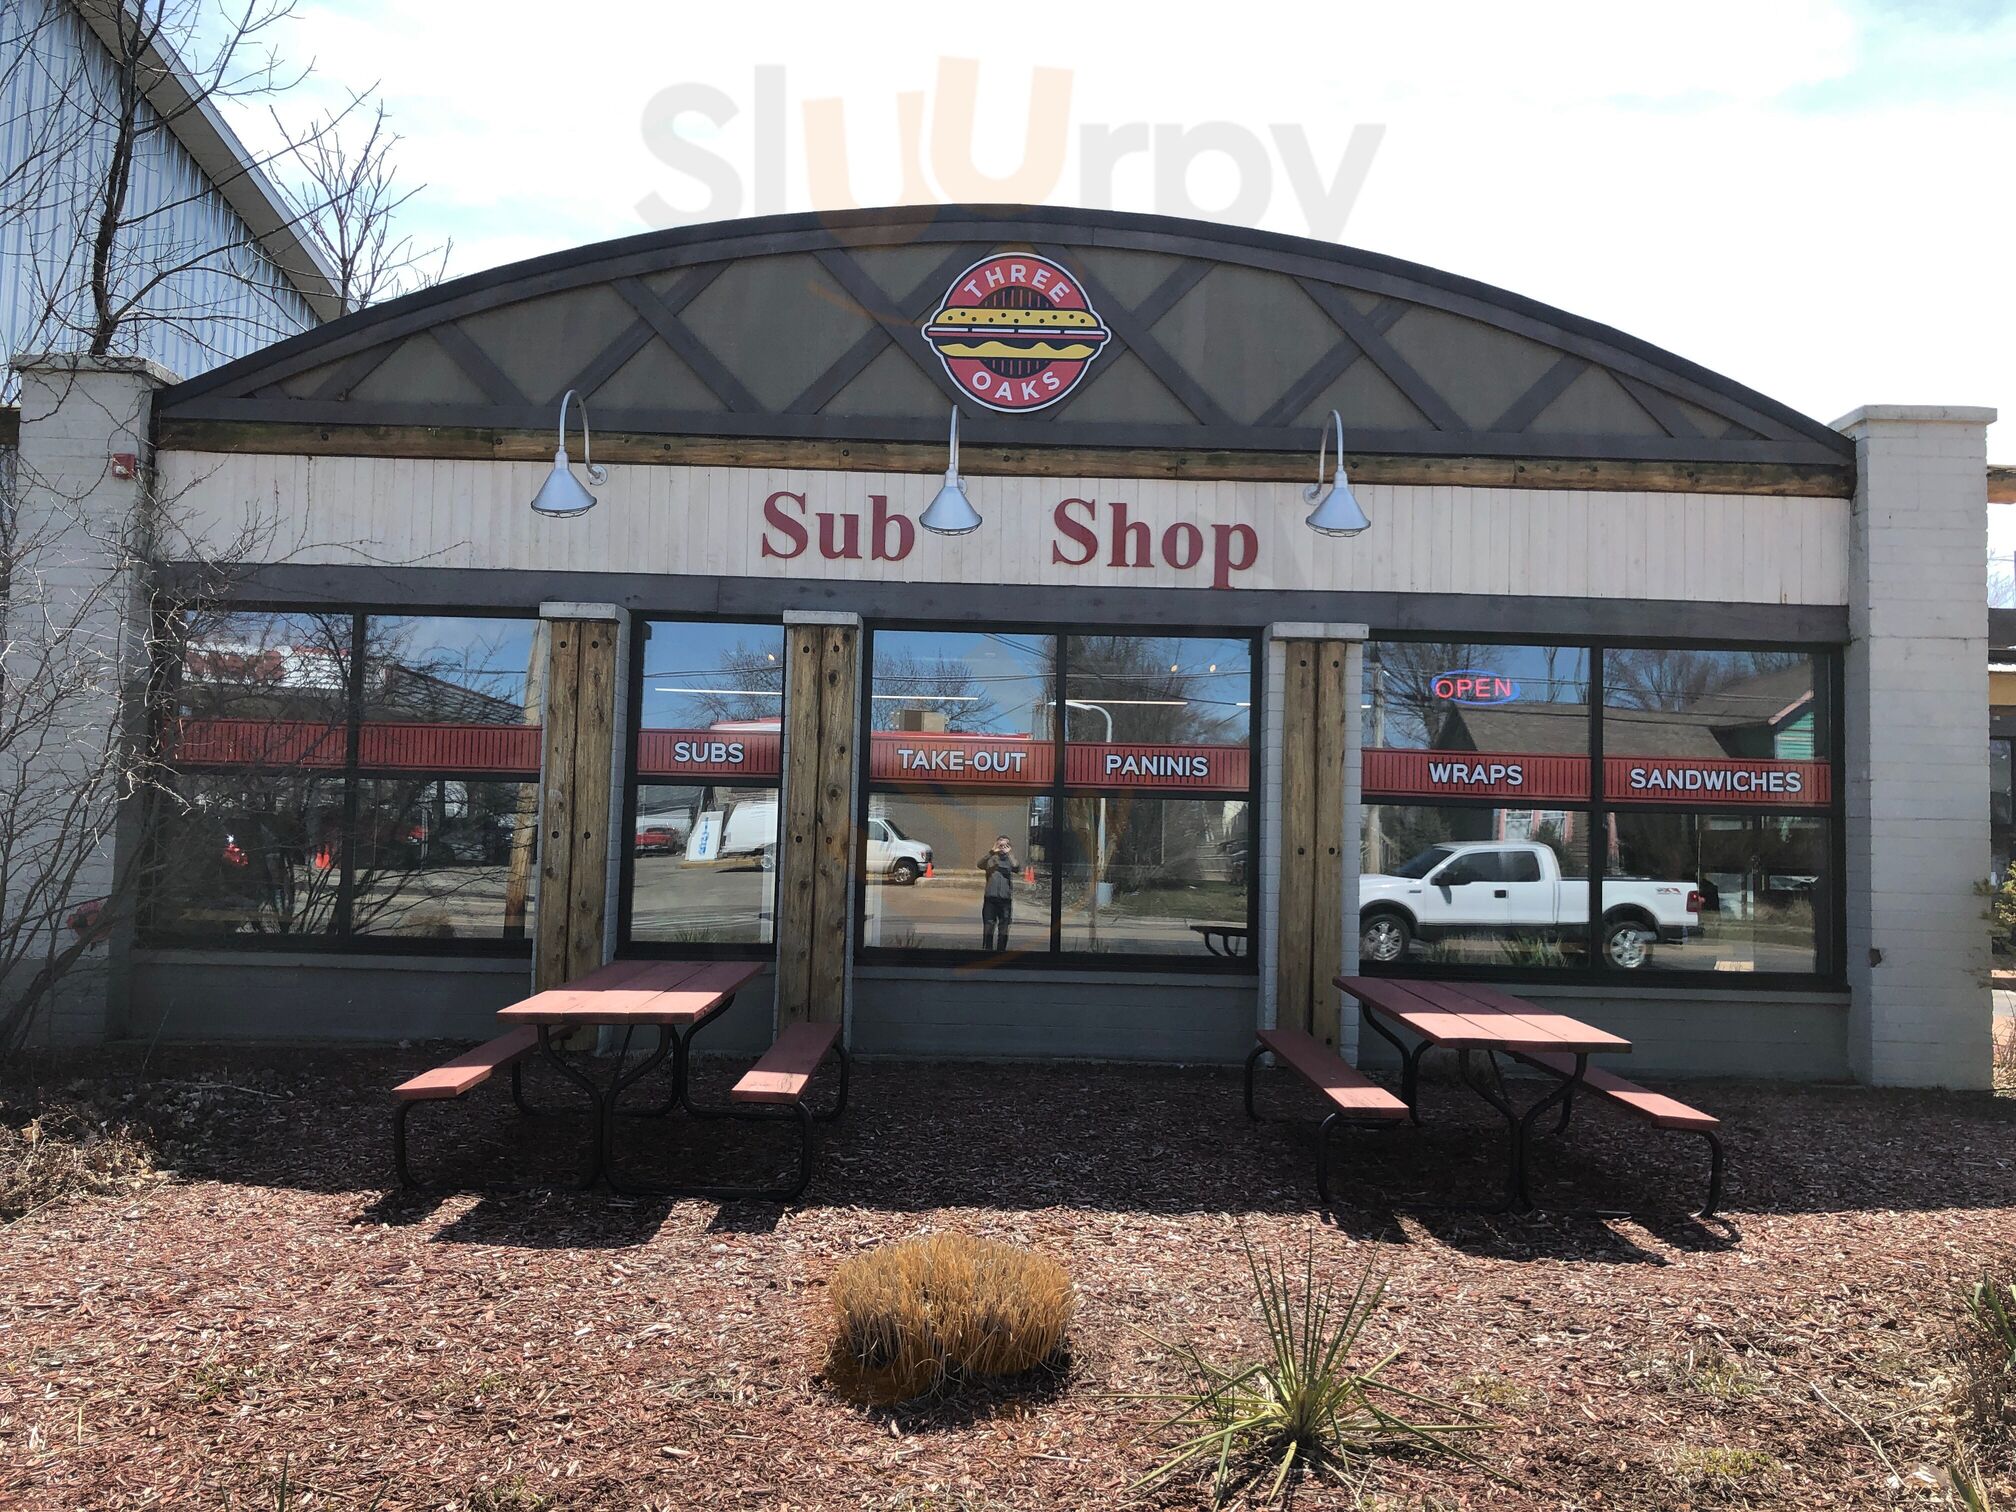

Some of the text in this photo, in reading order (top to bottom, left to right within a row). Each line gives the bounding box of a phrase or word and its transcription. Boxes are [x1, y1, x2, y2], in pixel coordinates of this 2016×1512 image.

[964, 264, 1070, 303] THREE
[972, 371, 1060, 401] OAKS
[761, 491, 1259, 590] Sub Shop
[1435, 678, 1512, 698] OPEN
[673, 740, 744, 764] SUBS
[898, 748, 1027, 773] TAKE-OUT
[1105, 754, 1210, 778] PANINIS
[1428, 763, 1524, 786] WRAPS
[1630, 768, 1802, 793] SANDWICHES
